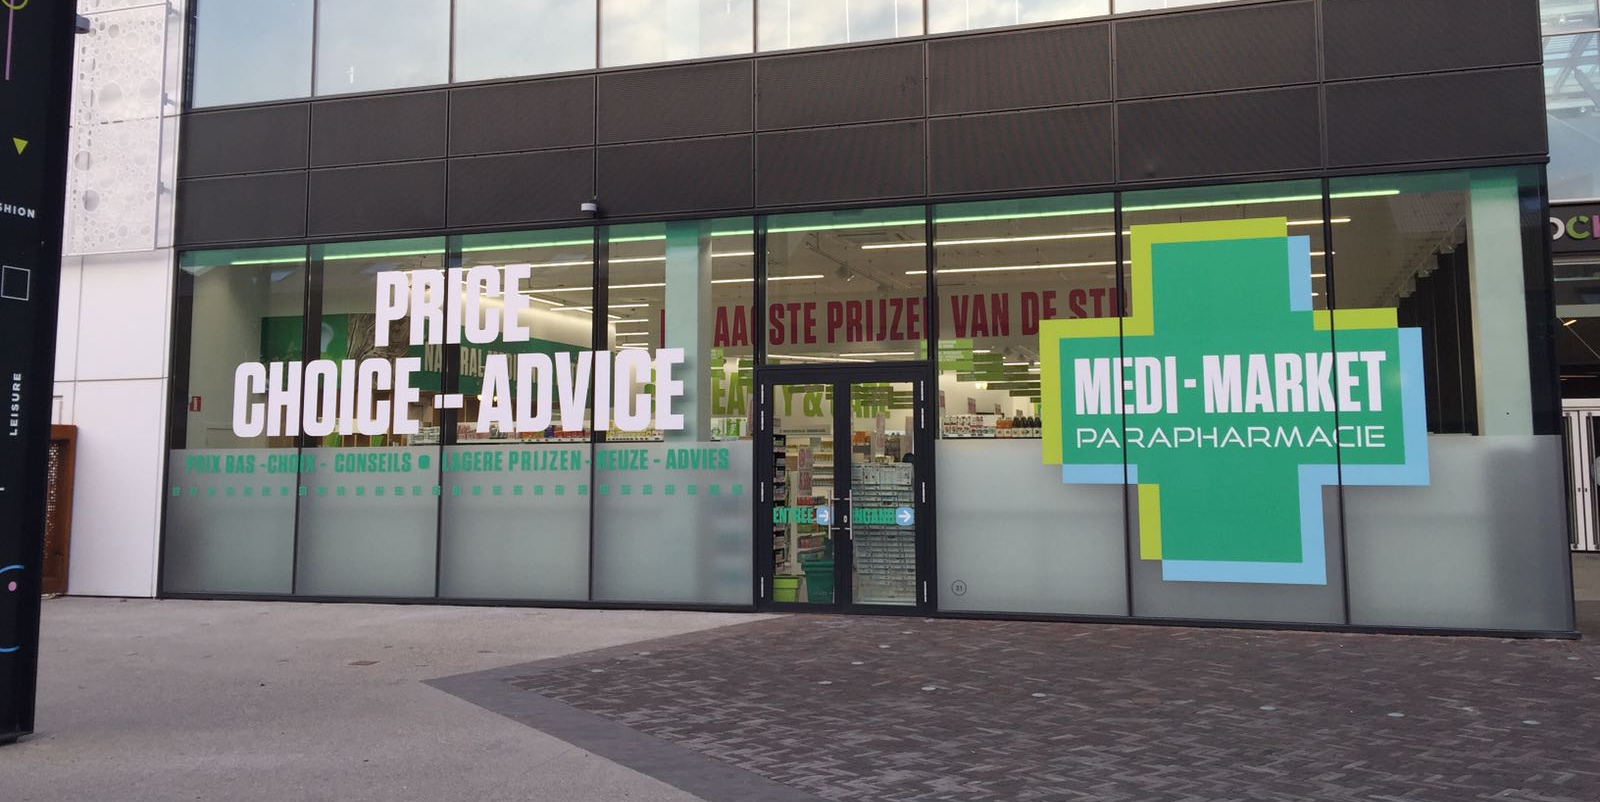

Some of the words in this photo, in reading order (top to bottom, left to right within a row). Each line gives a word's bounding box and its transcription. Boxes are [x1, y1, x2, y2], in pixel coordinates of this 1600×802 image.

[375, 264, 532, 347] PRICE
[713, 302, 817, 347] AASTE
[951, 293, 1010, 338] VAN
[424, 343, 484, 377] NARAL
[9, 373, 22, 436] LEISURE
[232, 357, 421, 438] CHOICE
[476, 348, 685, 433] ADVICE
[225, 454, 255, 474] BAS
[334, 452, 412, 473] CONSEILS
[442, 450, 503, 472] LAGERE
[665, 448, 730, 470] ADVIES
[1076, 425, 1386, 449] PARAPHARMACIE
